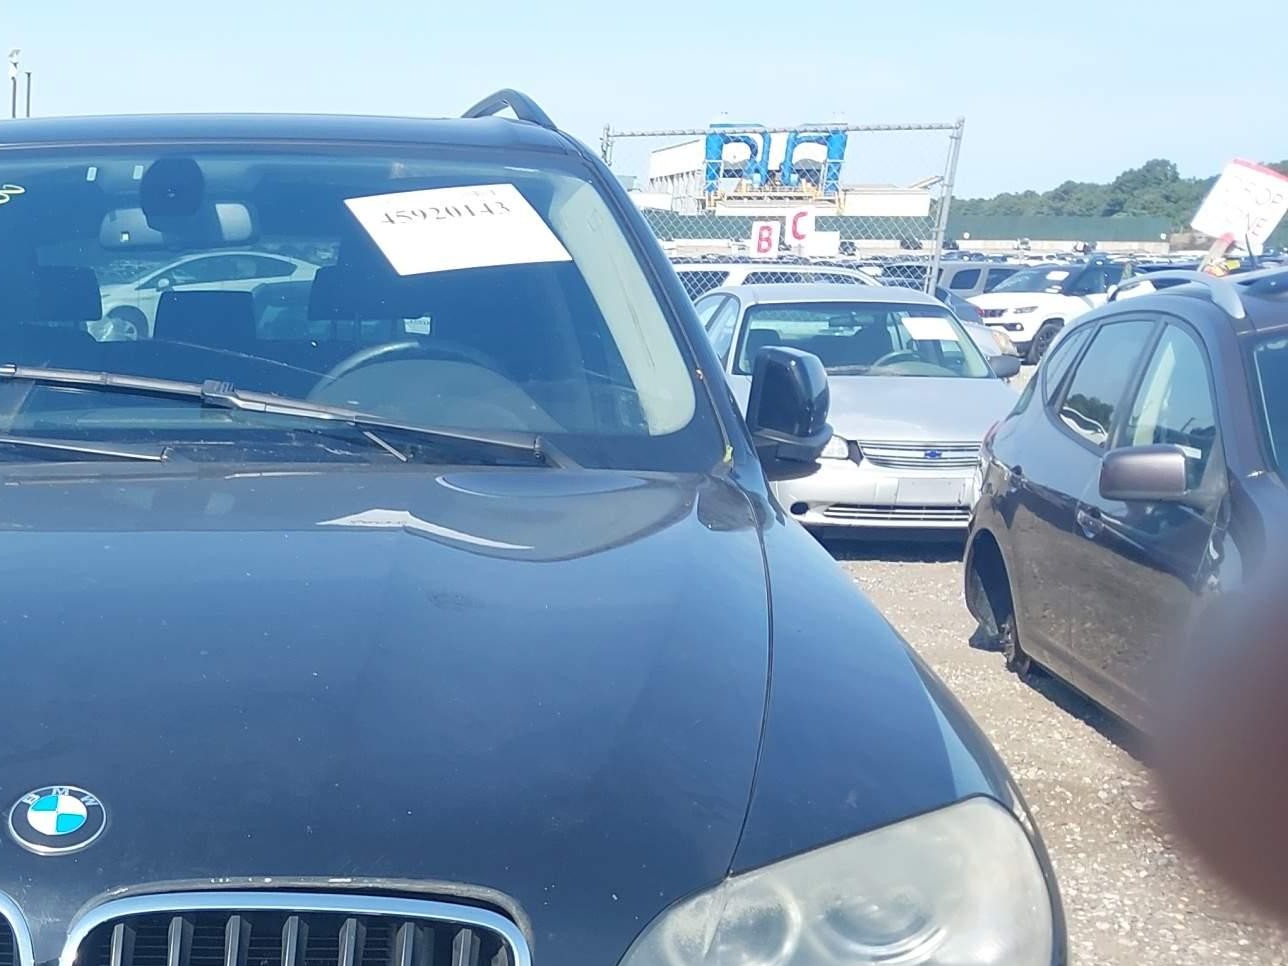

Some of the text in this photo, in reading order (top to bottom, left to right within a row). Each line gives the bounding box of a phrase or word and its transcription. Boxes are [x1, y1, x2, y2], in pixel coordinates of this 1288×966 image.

[381, 200, 511, 225] 45920143
[792, 211, 808, 240] C
[757, 225, 773, 253] B
[22, 787, 100, 807] BMW
